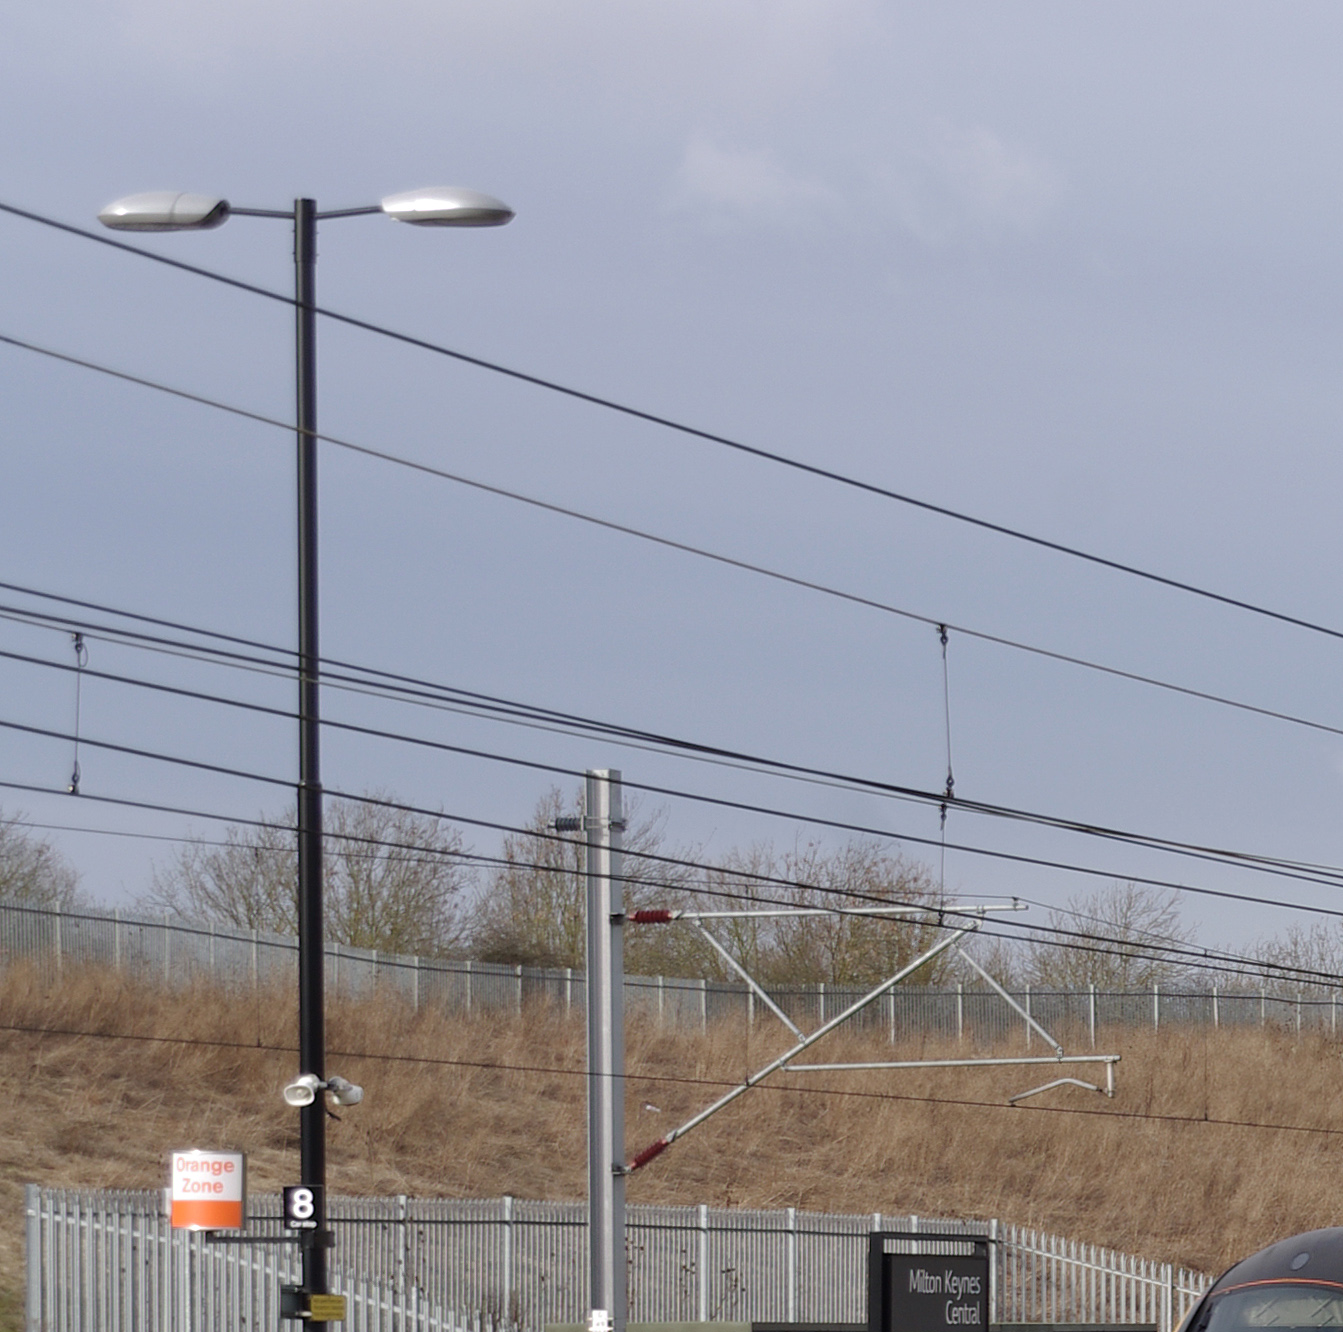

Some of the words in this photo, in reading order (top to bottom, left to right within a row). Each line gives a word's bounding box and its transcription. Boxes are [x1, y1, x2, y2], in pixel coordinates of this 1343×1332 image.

[176, 1156, 235, 1176] Orange
[181, 1177, 224, 1194] Zone
[293, 1188, 314, 1219] 8
[909, 1268, 942, 1294] Milton
[944, 1269, 981, 1301] Keynes
[945, 1300, 981, 1325] Central
